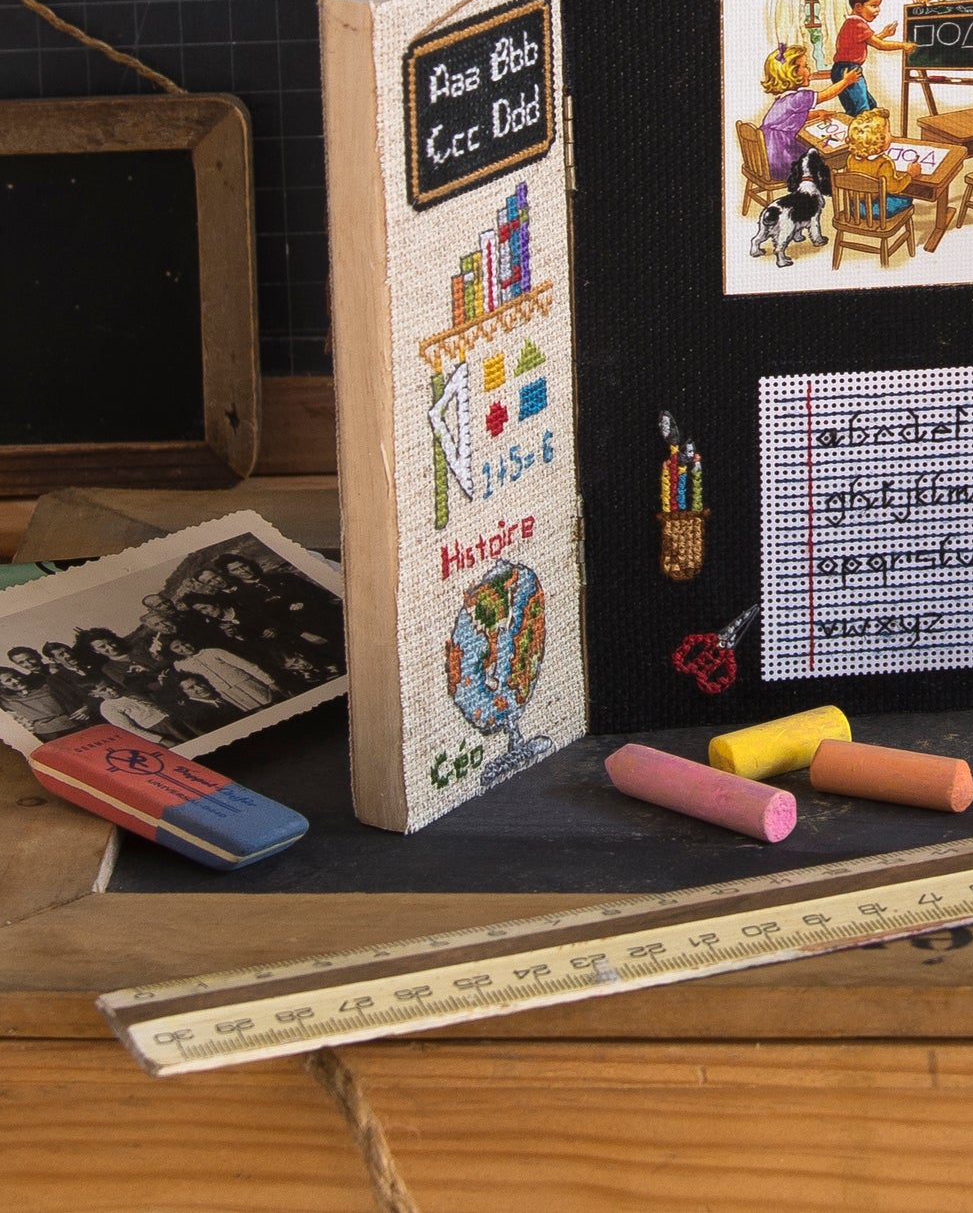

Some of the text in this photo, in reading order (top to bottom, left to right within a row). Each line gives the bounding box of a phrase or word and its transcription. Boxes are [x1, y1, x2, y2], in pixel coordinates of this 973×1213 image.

[429, 32, 538, 104] Aaa Bbb
[426, 84, 540, 164] Ccc Ddd
[440, 514, 536, 580] Histoire
[430, 738, 484, 789] Géo
